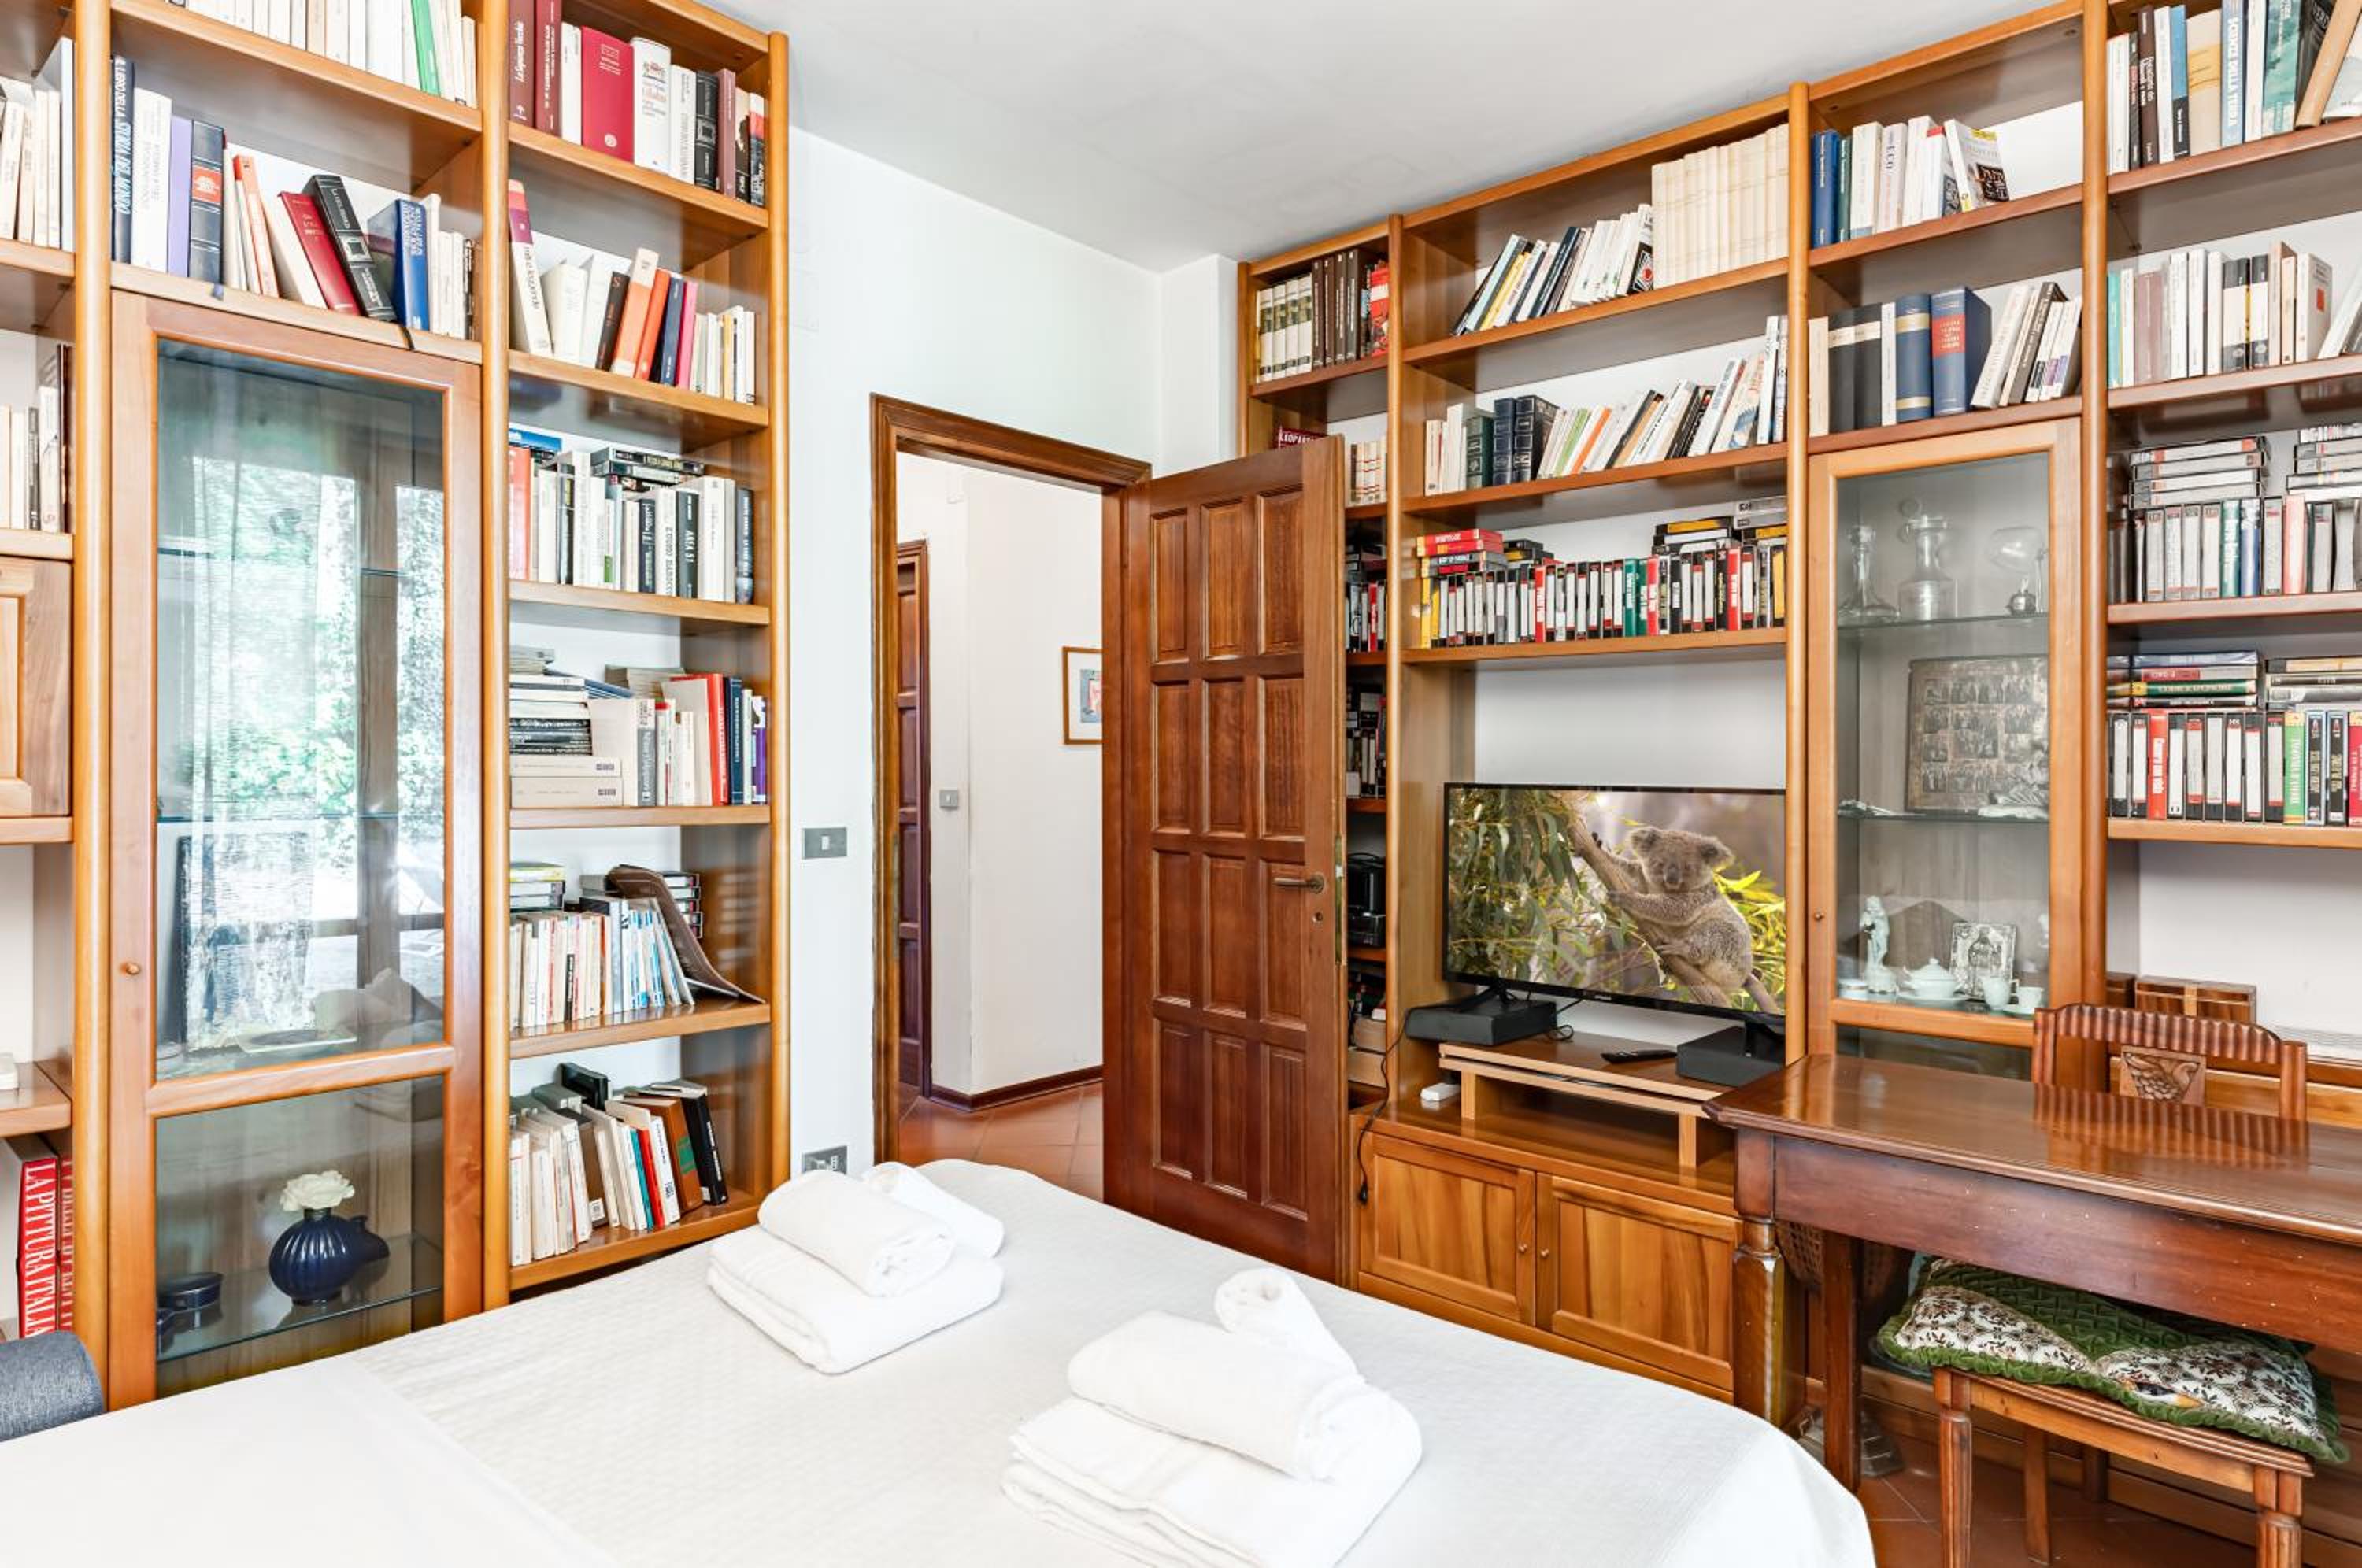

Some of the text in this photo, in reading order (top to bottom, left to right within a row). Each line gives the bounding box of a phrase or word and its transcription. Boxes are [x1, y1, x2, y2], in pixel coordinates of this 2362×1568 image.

[115, 67, 126, 91] LIBRO
[115, 92, 126, 117] DELLA
[115, 121, 131, 155] STORIA
[114, 155, 130, 176] DEL
[115, 176, 130, 215] MONDO
[684, 530, 695, 550] AREA
[25, 1161, 56, 1191] LA
[24, 1192, 56, 1276] PITTURA
